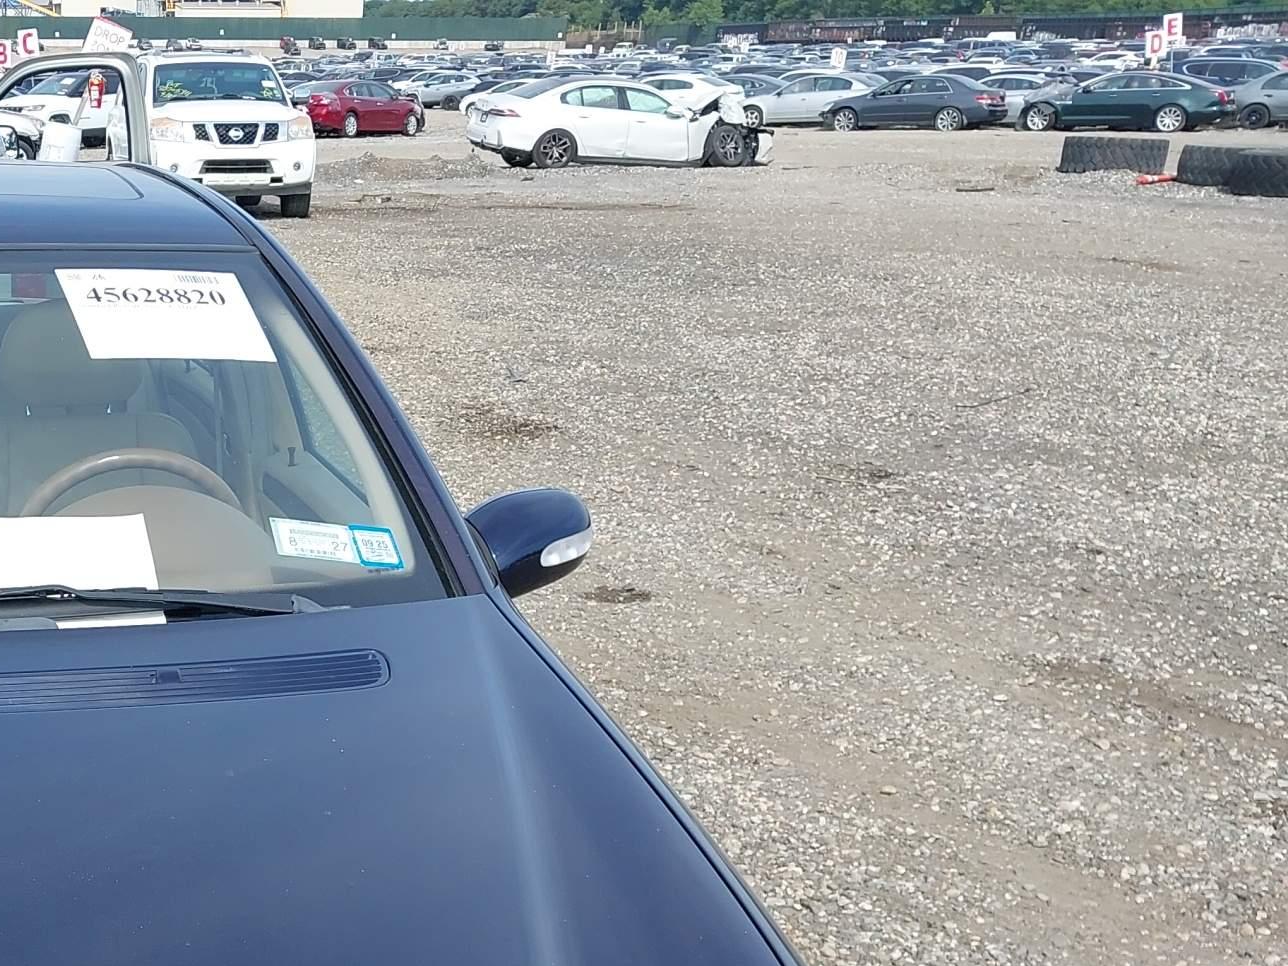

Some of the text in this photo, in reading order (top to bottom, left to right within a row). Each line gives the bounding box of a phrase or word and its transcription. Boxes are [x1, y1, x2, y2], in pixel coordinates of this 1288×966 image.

[94, 25, 126, 46] DROP
[1167, 17, 1178, 37] E
[22, 32, 34, 55] C
[1150, 33, 1162, 54] D
[86, 287, 226, 306] 45628820
[331, 541, 348, 552] 27
[376, 539, 389, 549] 25
